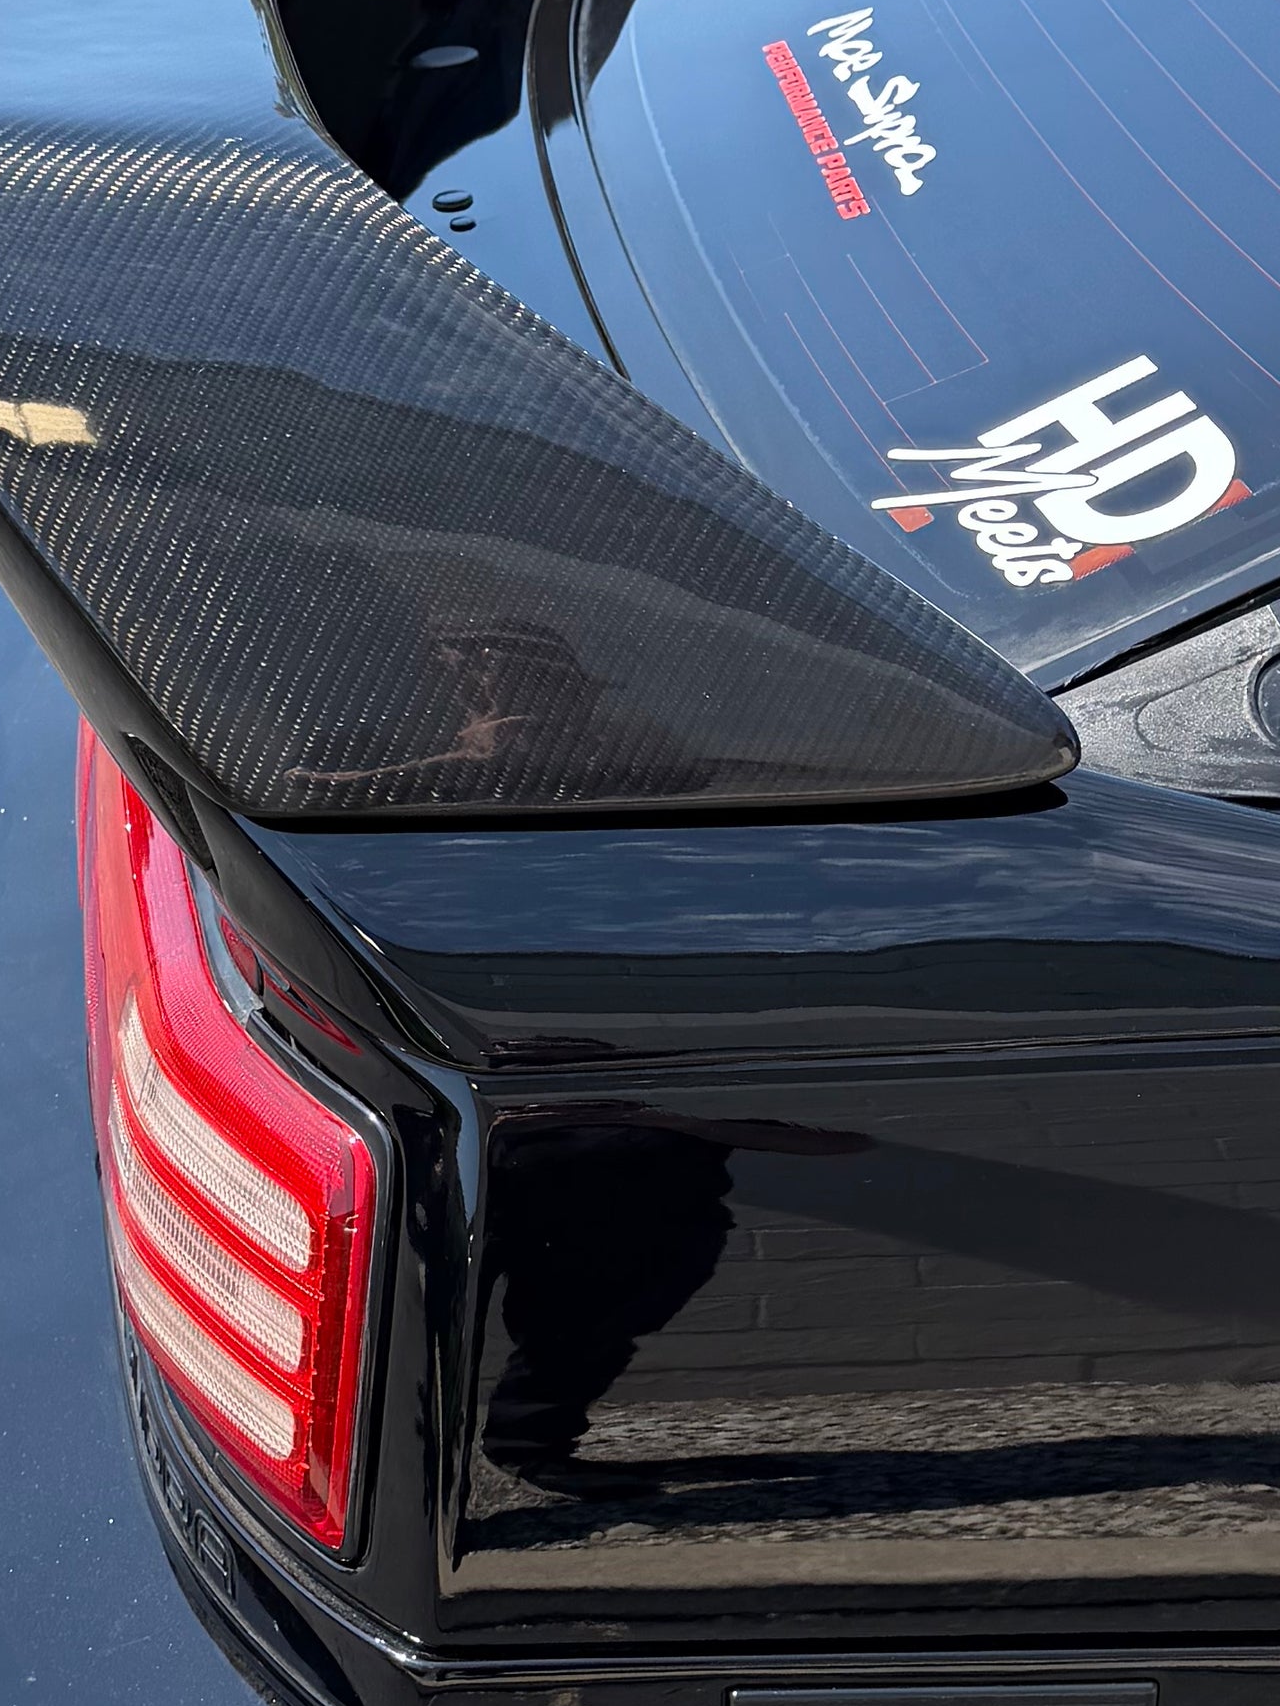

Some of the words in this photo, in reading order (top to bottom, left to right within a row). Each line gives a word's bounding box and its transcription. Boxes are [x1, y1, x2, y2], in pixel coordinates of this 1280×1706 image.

[762, 40, 839, 156] PERFORMANCE
[817, 151, 871, 220] PARTS
[843, 75, 937, 196] Supra
[871, 442, 1099, 587] Meets
[977, 354, 1236, 545] HD
